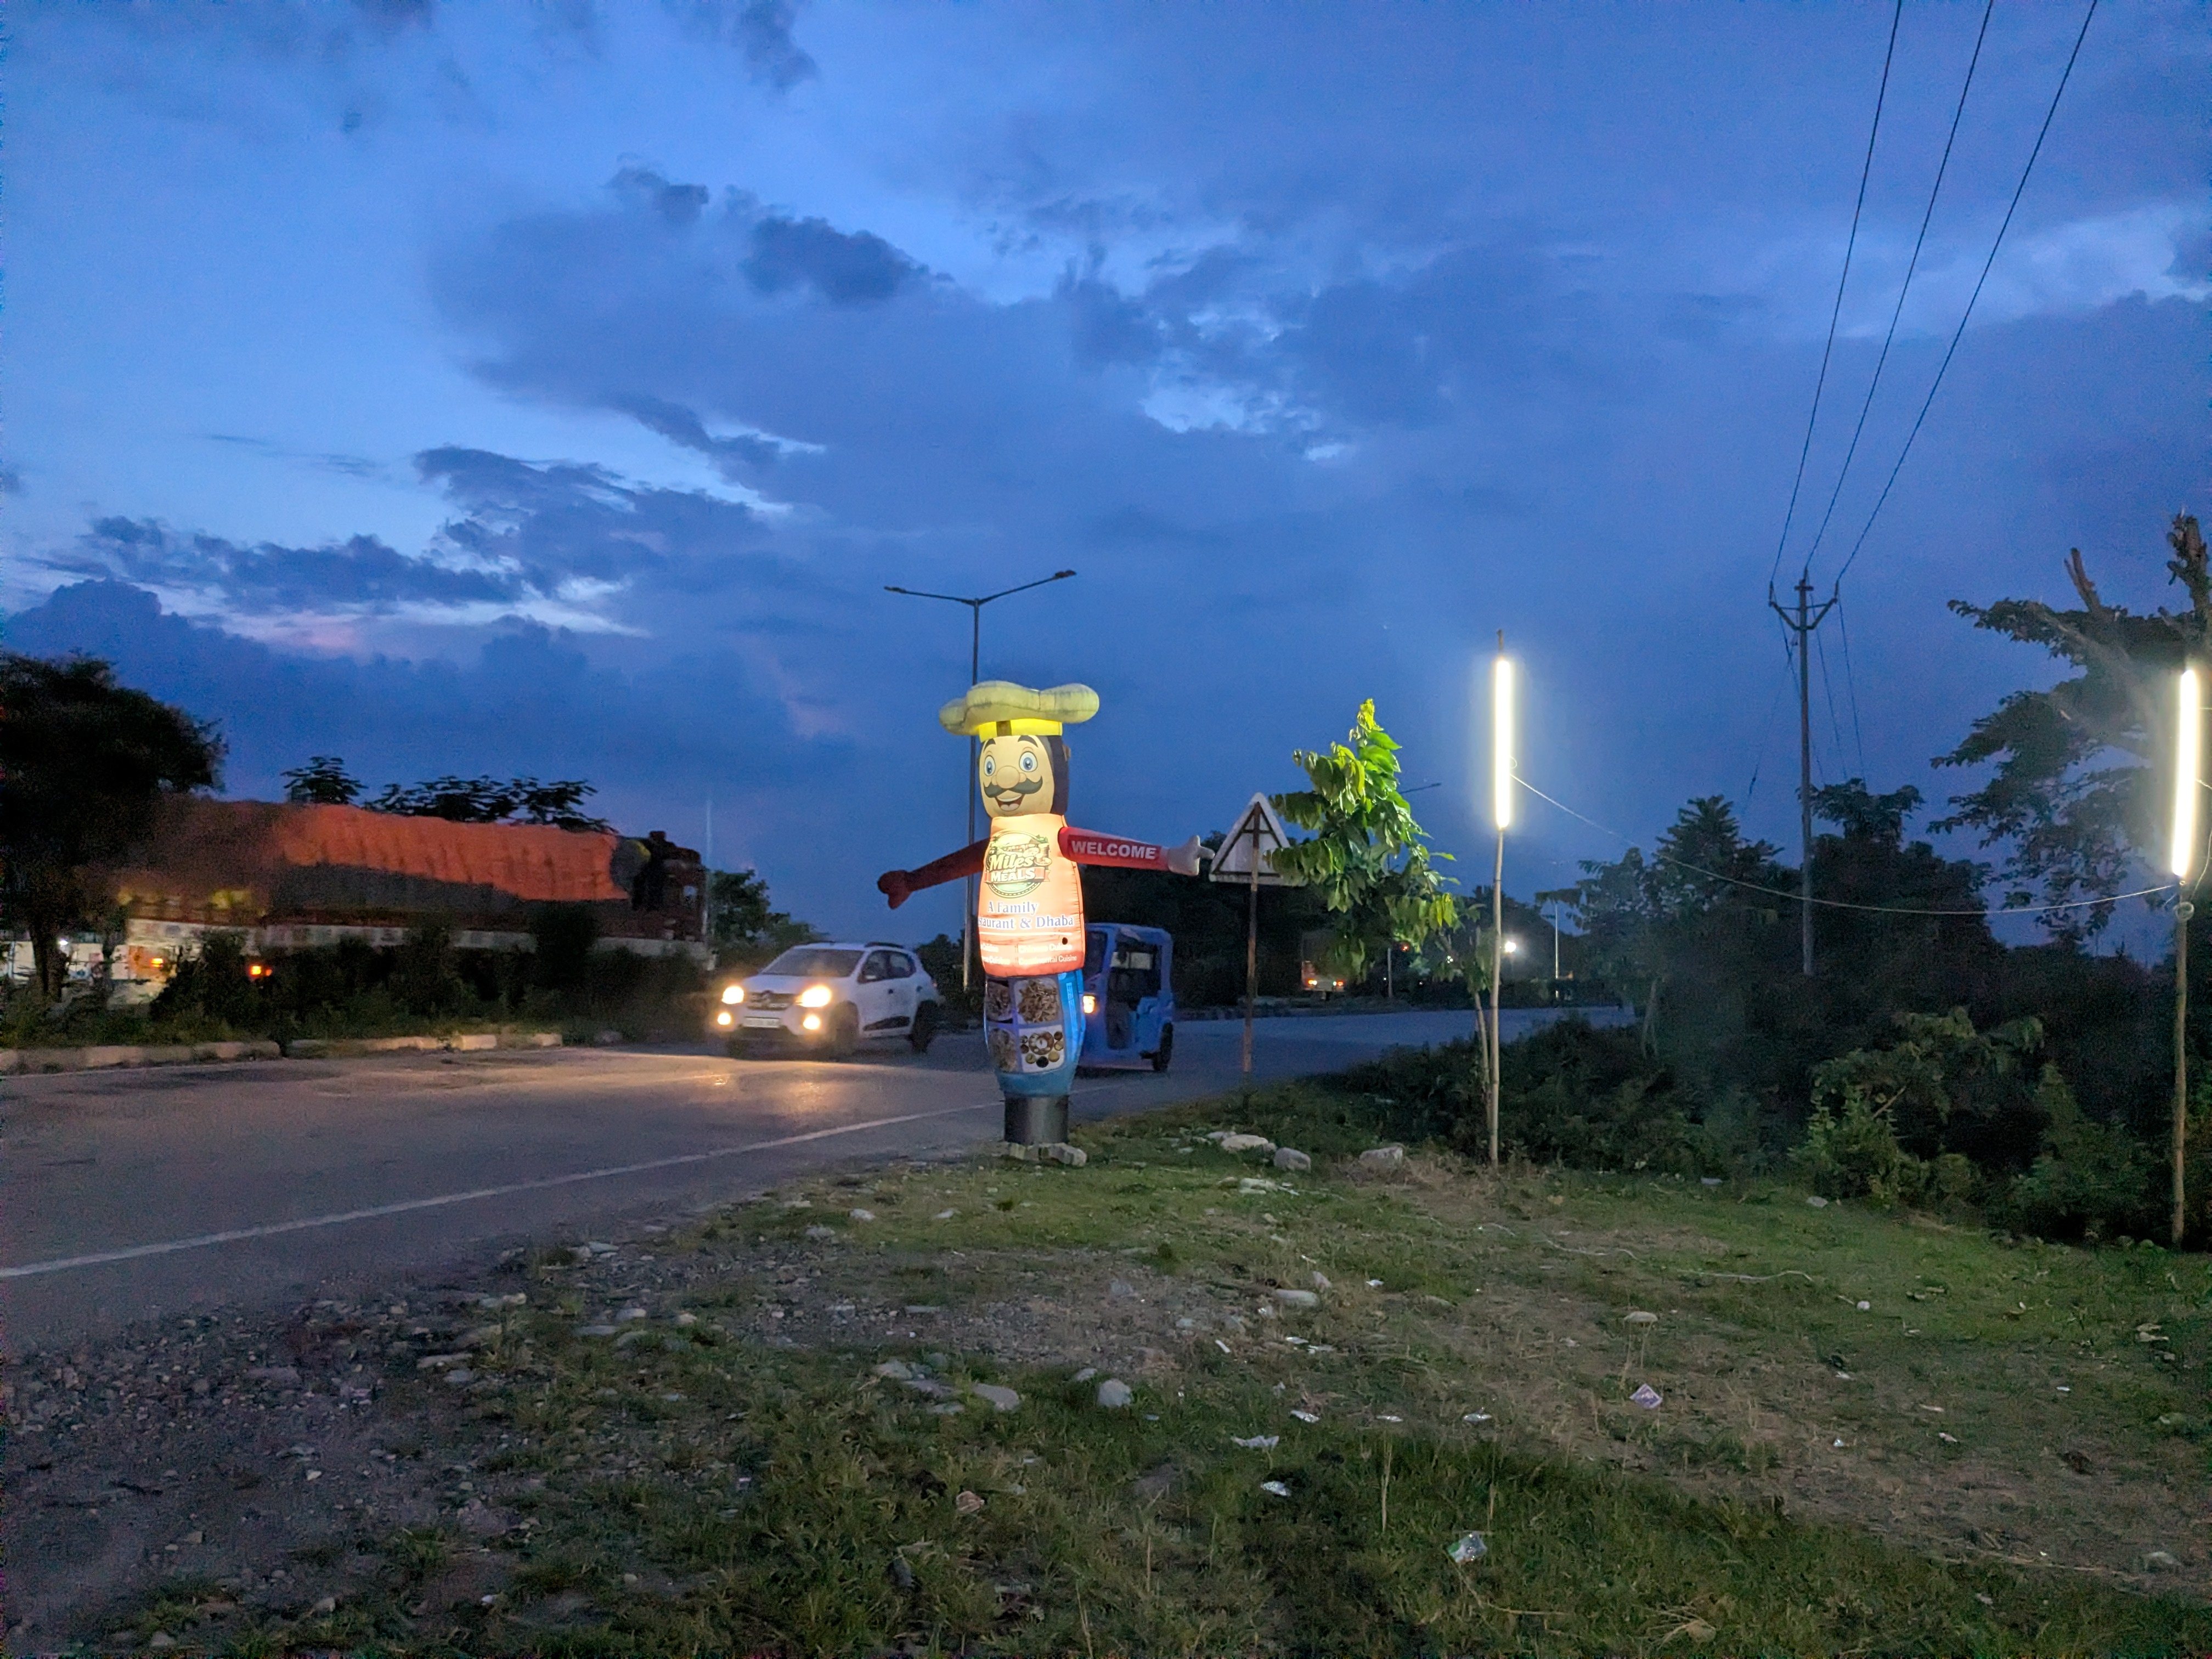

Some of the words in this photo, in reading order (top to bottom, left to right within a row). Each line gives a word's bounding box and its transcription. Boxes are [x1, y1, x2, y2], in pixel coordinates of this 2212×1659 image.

[1071, 840, 1157, 859] WELCOME
[990, 854, 1035, 871] Miles
[991, 868, 1035, 882] MEALS
[988, 901, 994, 912] A
[997, 901, 1037, 915] Family
[978, 917, 1014, 928] staurant
[1020, 918, 1031, 928] &
[1036, 915, 1074, 927] Dhaba
[1058, 954, 1077, 963] Cuisine
